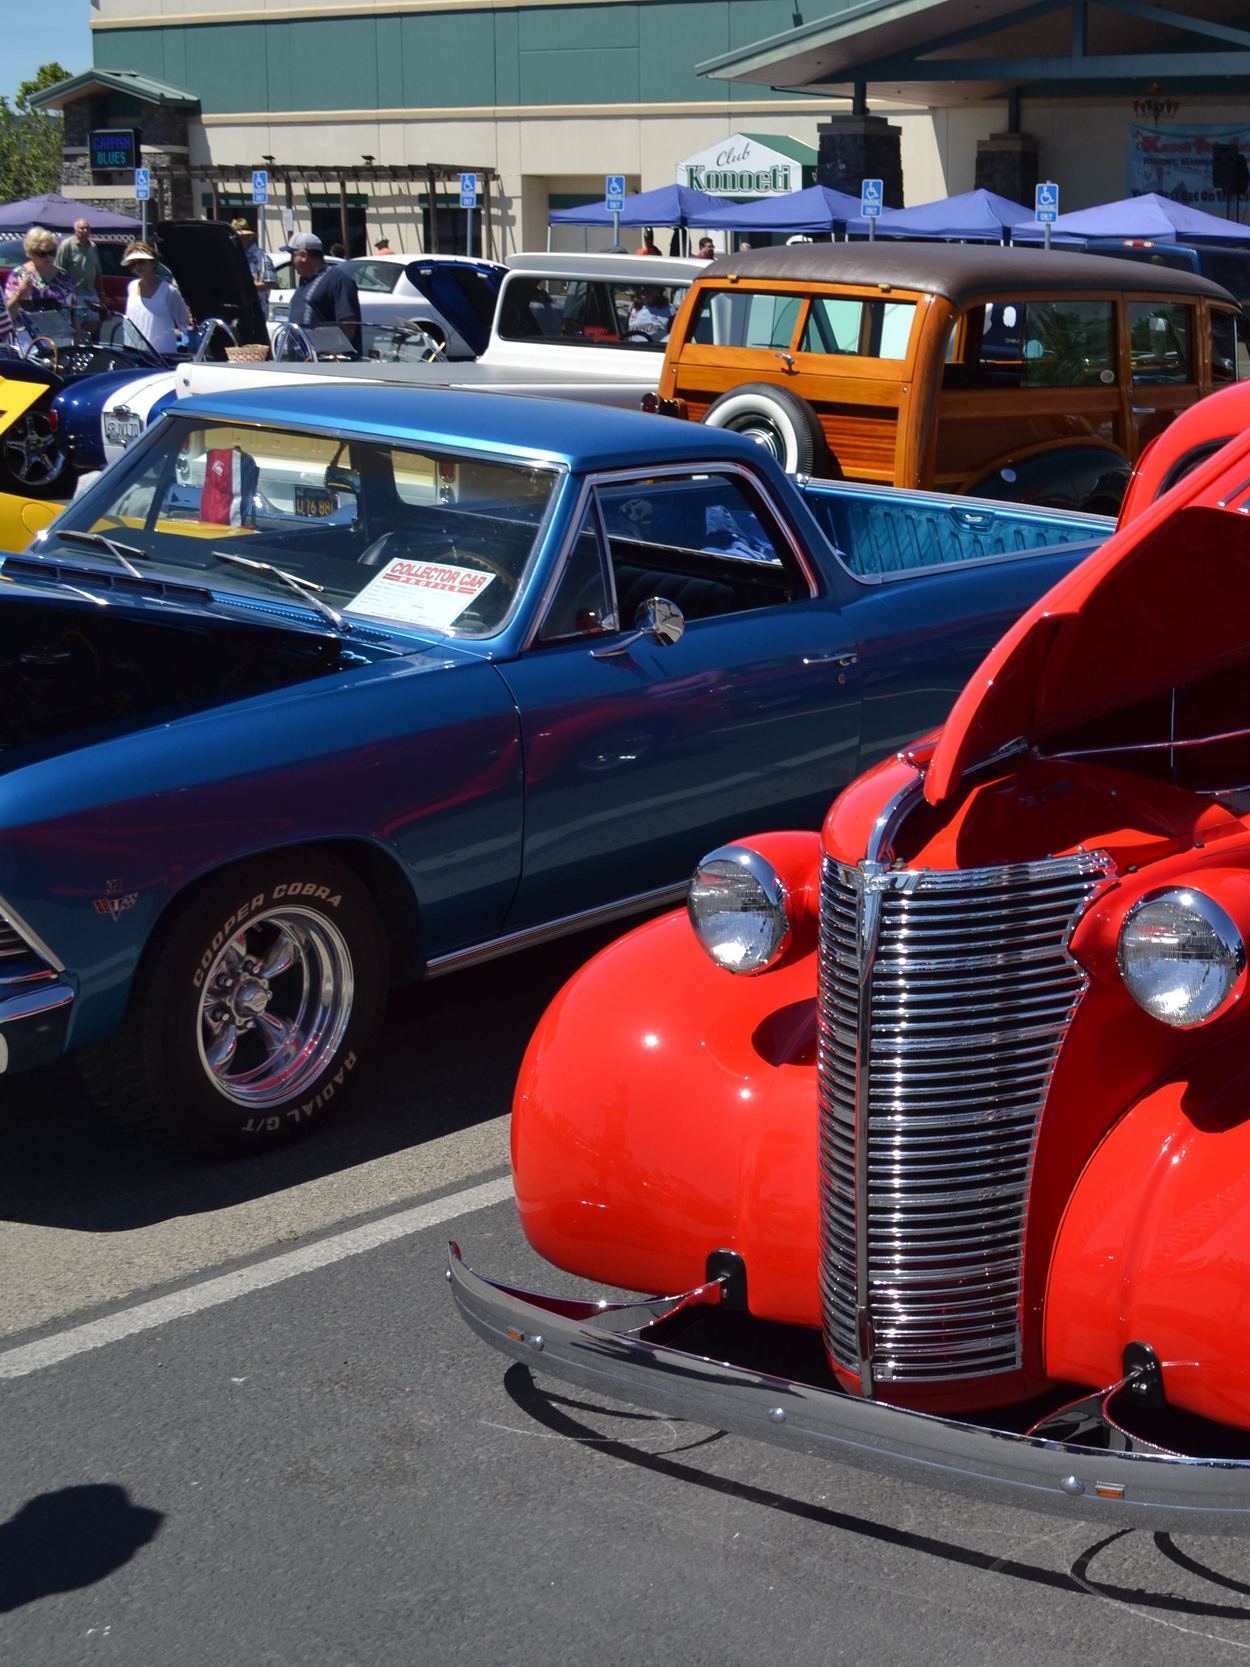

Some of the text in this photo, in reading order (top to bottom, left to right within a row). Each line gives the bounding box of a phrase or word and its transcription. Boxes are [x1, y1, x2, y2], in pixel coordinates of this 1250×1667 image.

[96, 151, 127, 165] BLUES
[716, 143, 750, 167] Club
[686, 165, 792, 193] Konocti
[390, 562, 488, 588] COLLECTOR CAR
[192, 882, 343, 988] COOPER COBRA
[241, 1050, 358, 1132] RADIAL G/T
